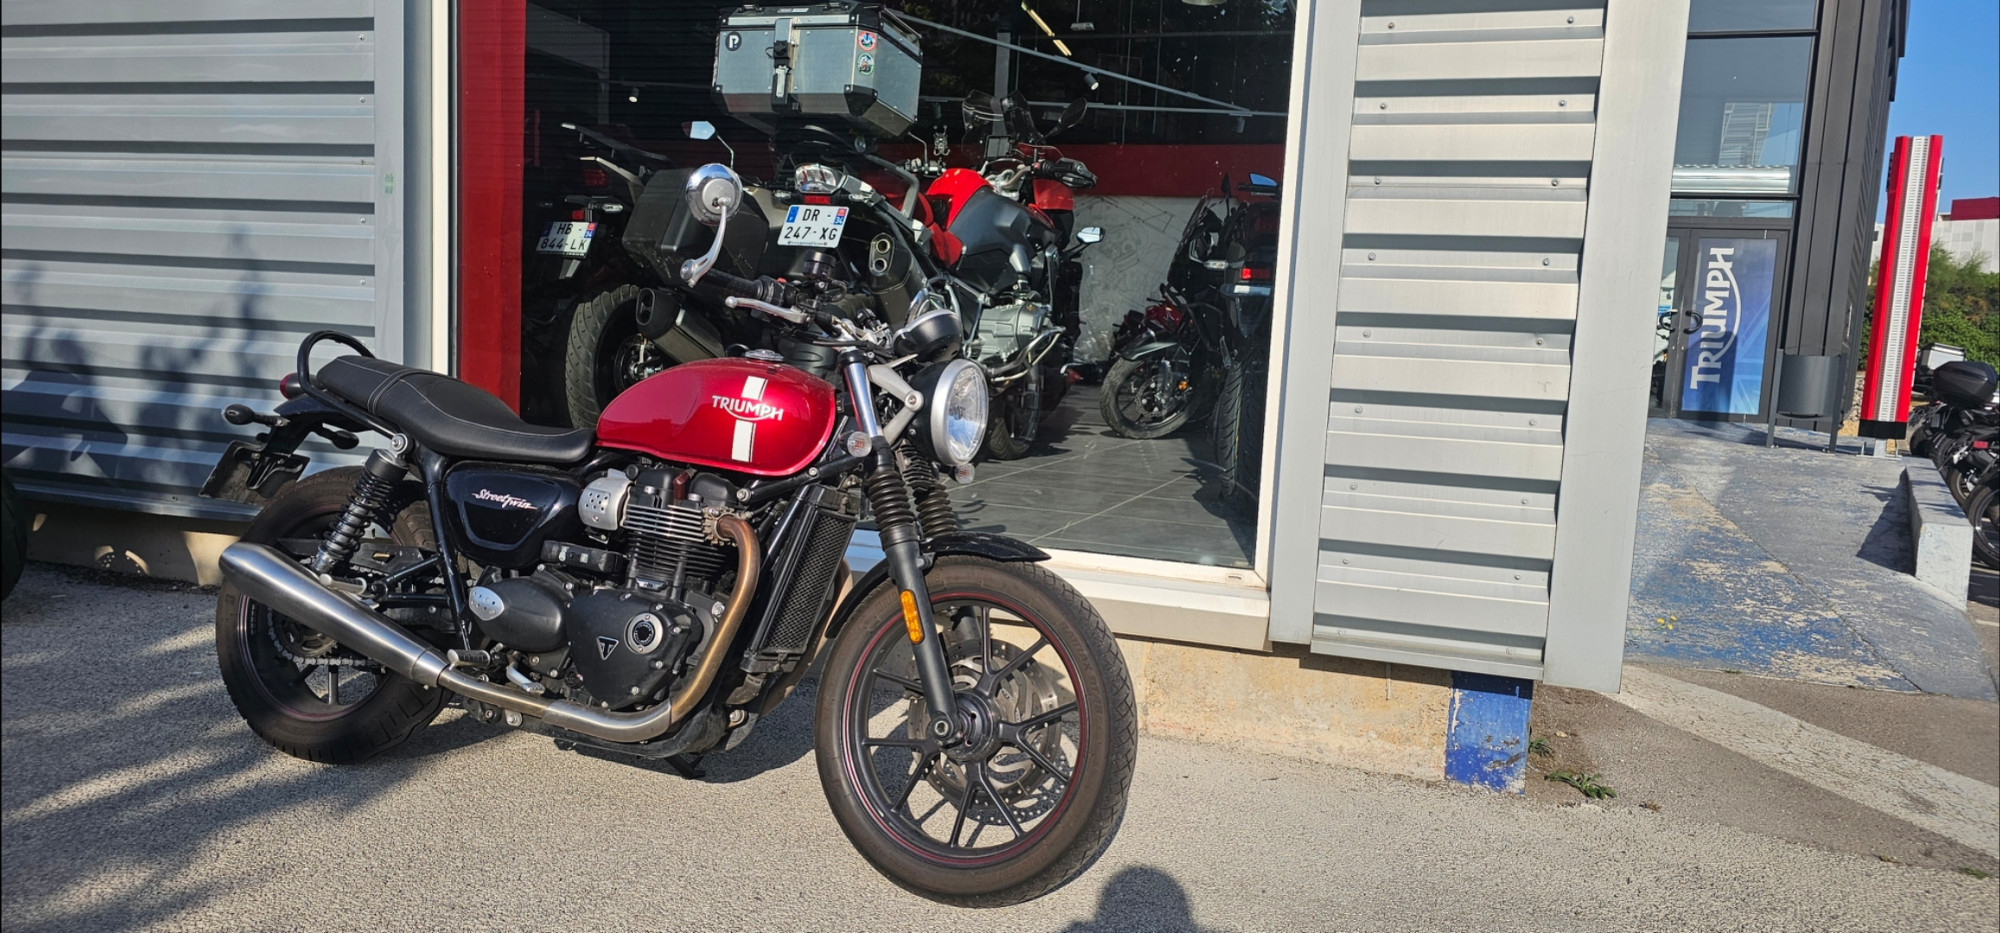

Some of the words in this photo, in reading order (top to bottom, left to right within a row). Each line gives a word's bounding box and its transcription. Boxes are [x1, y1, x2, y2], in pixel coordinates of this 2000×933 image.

[802, 208, 820, 221] DR
[557, 223, 573, 234] HB
[784, 226, 837, 240] 247-XG
[540, 238, 587, 250] 844-LK
[1690, 247, 1741, 390] TRIUMPH
[712, 395, 784, 421] TRIUMPH
